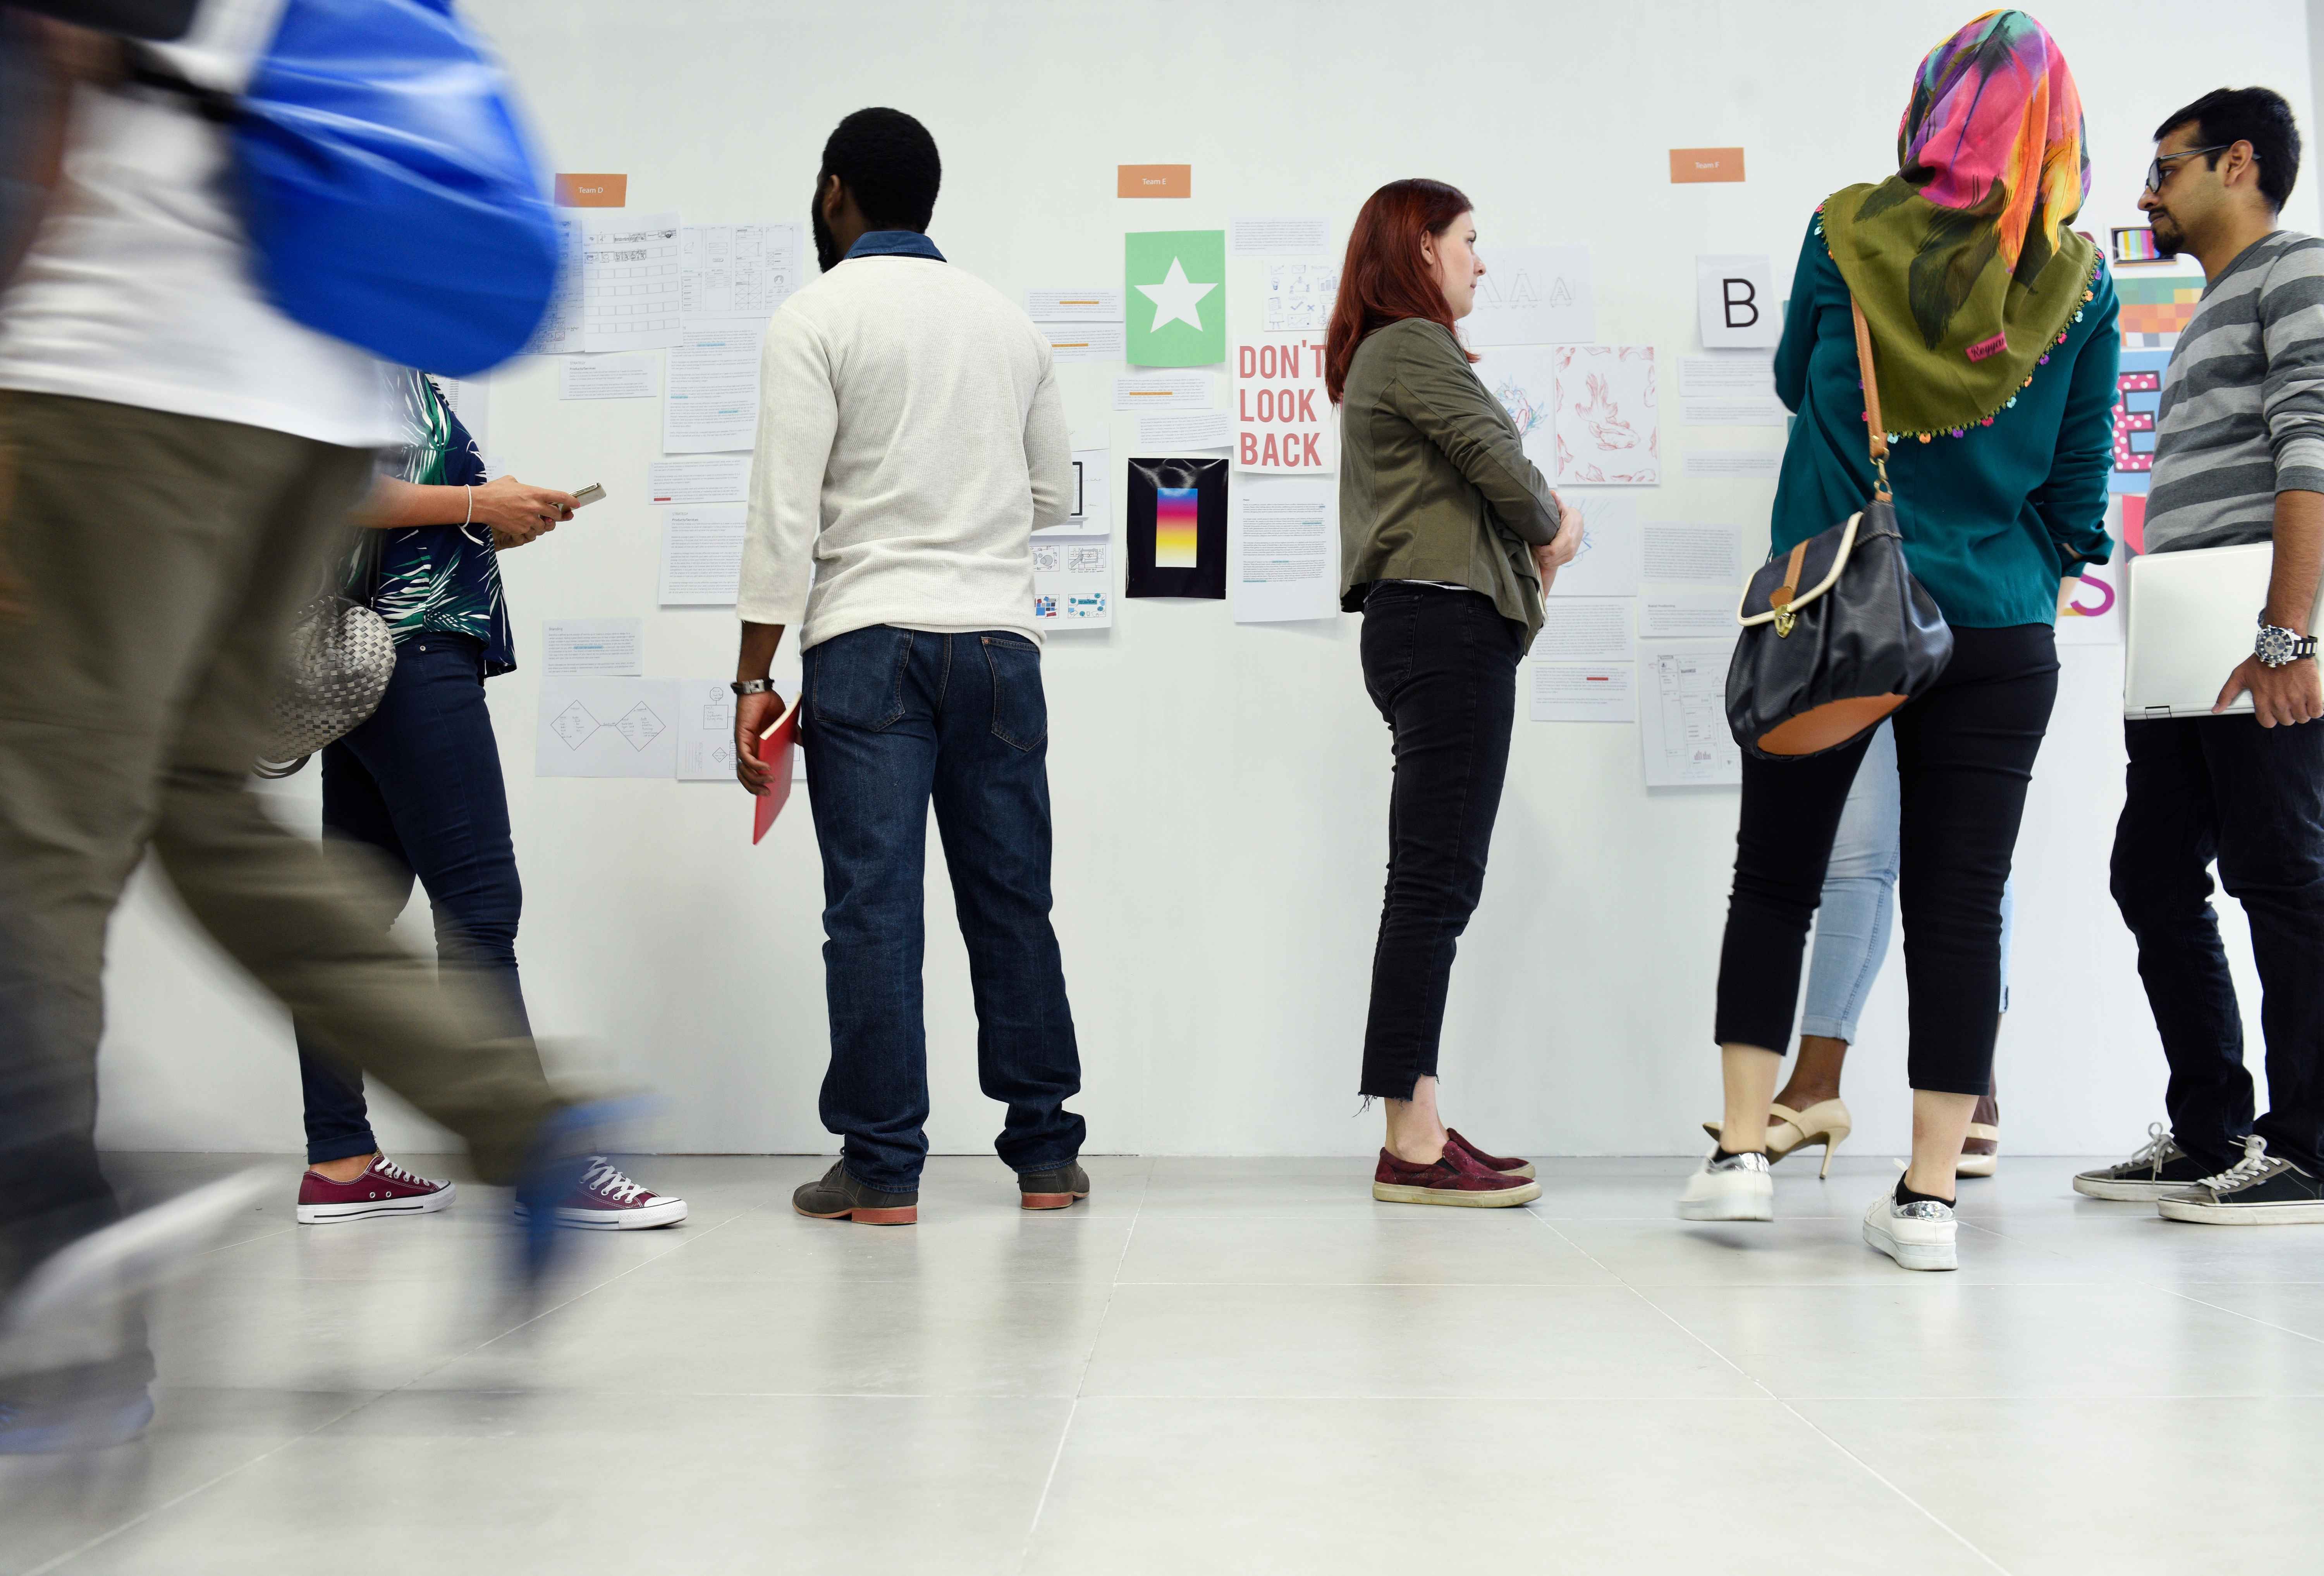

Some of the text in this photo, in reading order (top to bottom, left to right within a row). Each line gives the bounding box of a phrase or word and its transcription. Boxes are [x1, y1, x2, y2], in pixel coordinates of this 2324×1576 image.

[1723, 279, 1758, 327] B
[1240, 340, 1327, 379] DON'T
[1240, 389, 1317, 423] LOOK
[1241, 432, 1322, 467] BACK
